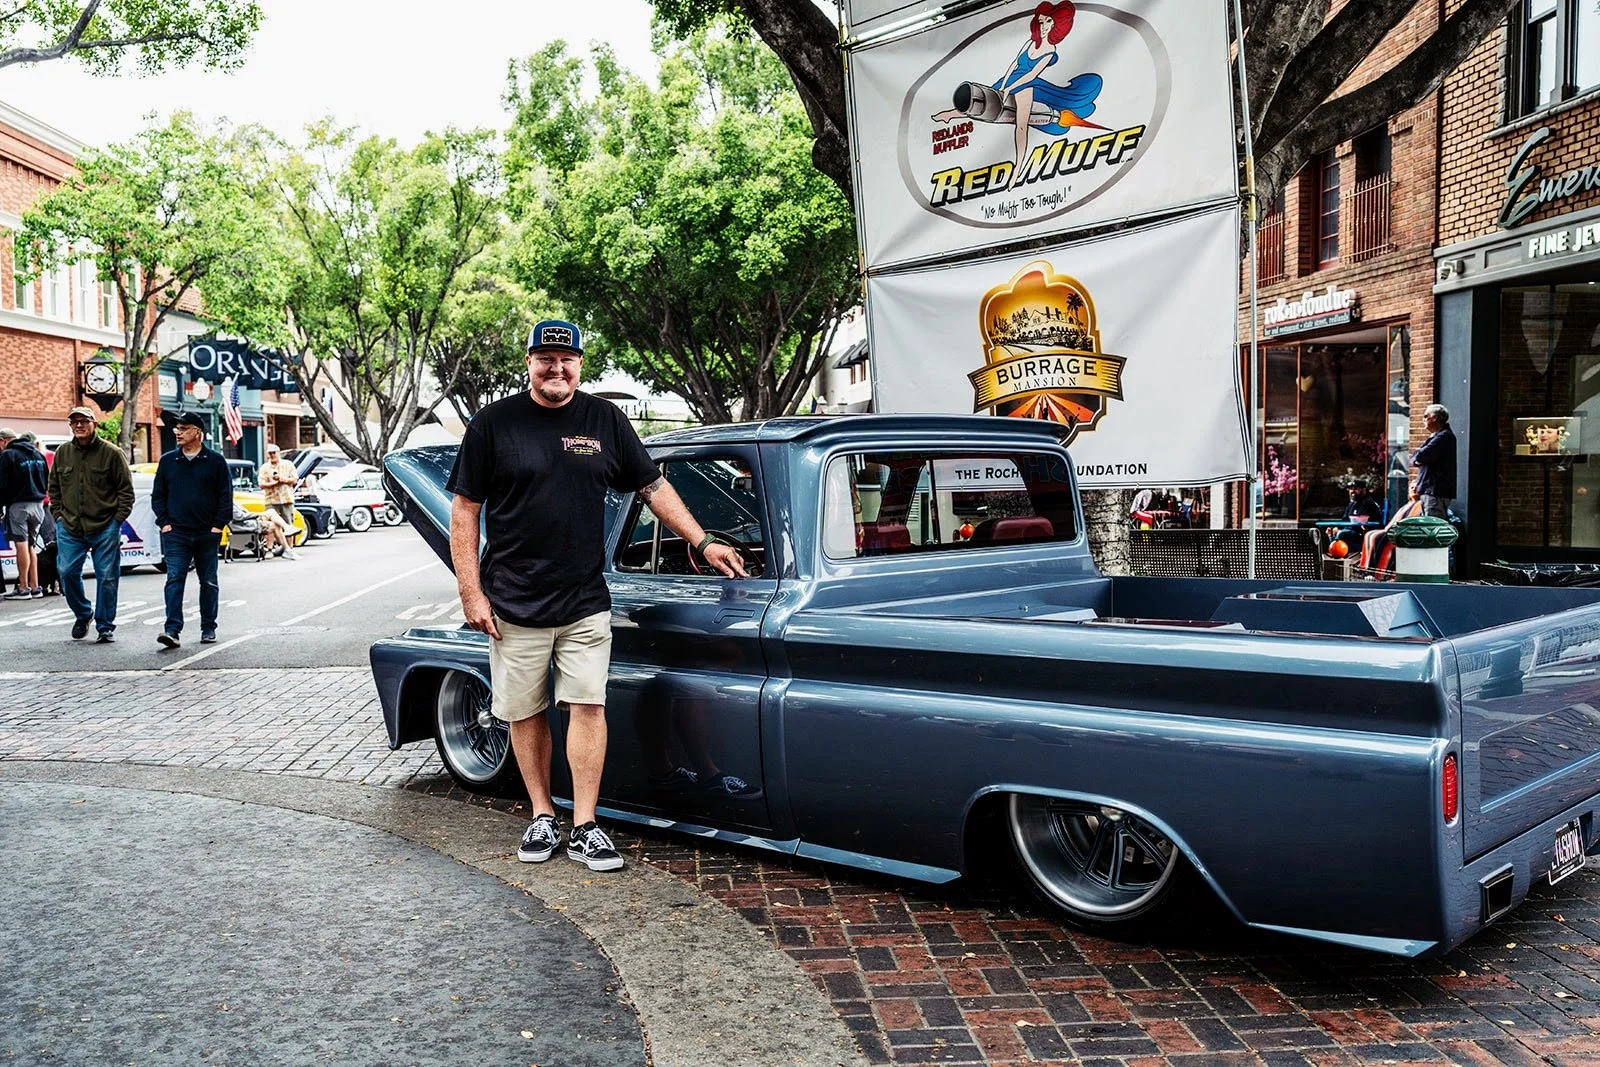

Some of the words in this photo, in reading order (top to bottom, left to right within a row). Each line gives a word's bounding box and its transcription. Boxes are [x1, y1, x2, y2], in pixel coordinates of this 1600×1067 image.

[932, 121, 974, 143] REDLANDS
[932, 135, 969, 155] MUFFLER
[929, 160, 1014, 208] RED
[1016, 124, 1146, 185] MUFF
[997, 201, 1018, 219] Muff
[1020, 196, 1036, 211] Too
[1529, 231, 1569, 258] FINE
[190, 344, 296, 384] ORANGE
[996, 358, 1098, 385] BURRAGE
[1012, 376, 1078, 393] MANSION
[955, 469, 980, 480] THE
